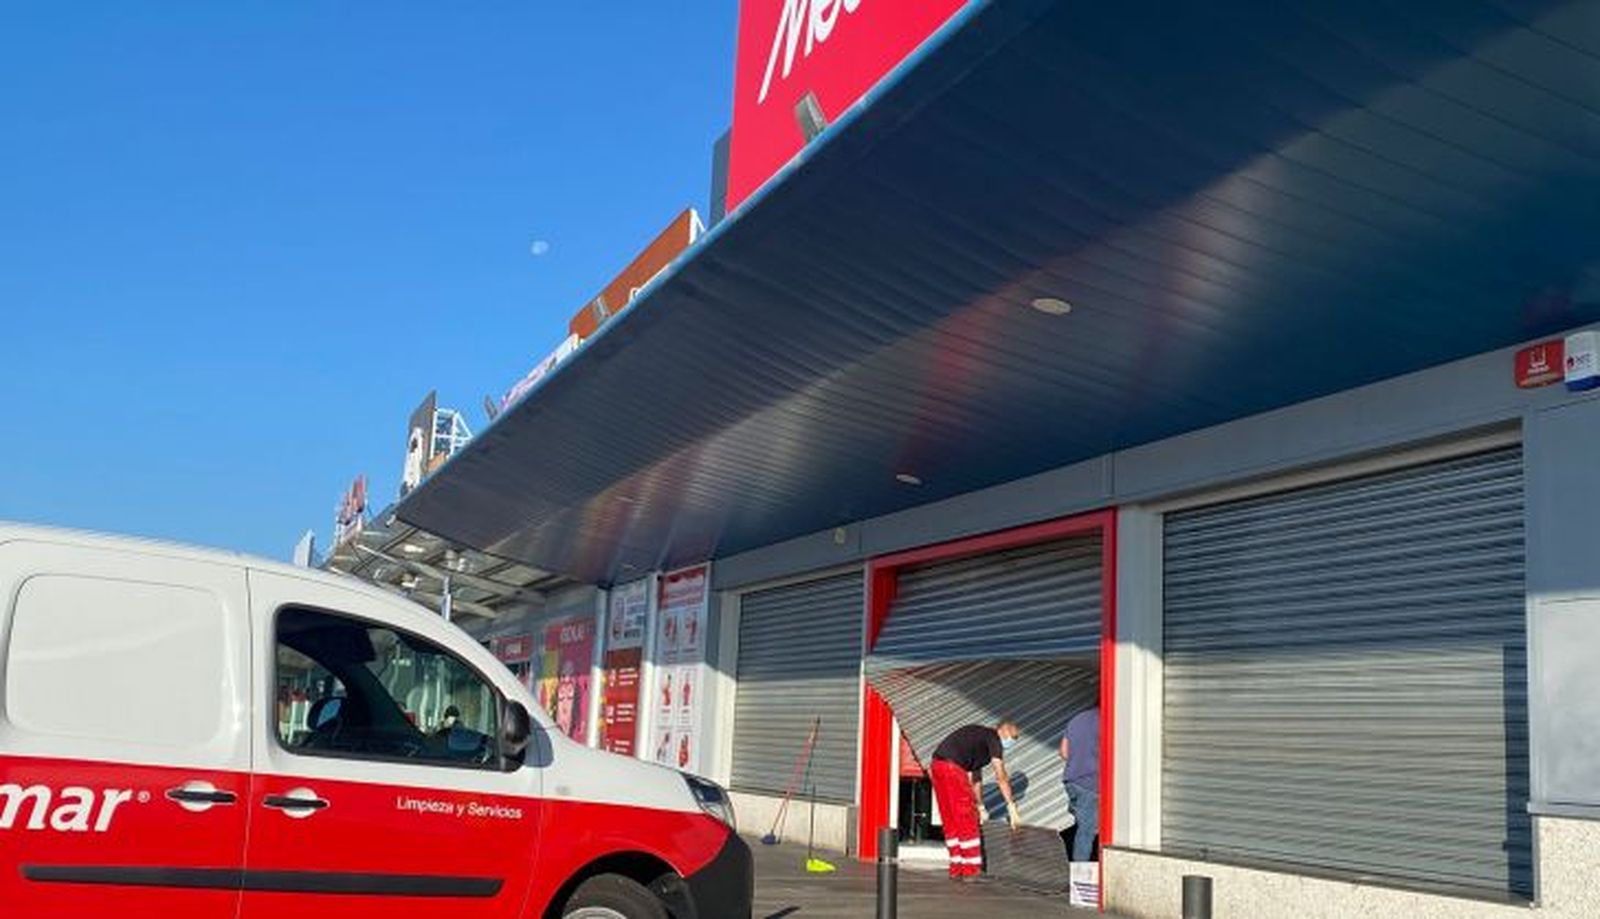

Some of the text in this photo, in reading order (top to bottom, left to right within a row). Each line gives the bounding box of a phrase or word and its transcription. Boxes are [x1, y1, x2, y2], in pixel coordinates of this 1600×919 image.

[757, 0, 861, 104] Me
[396, 796, 523, 819] Limpieza y Servicios
